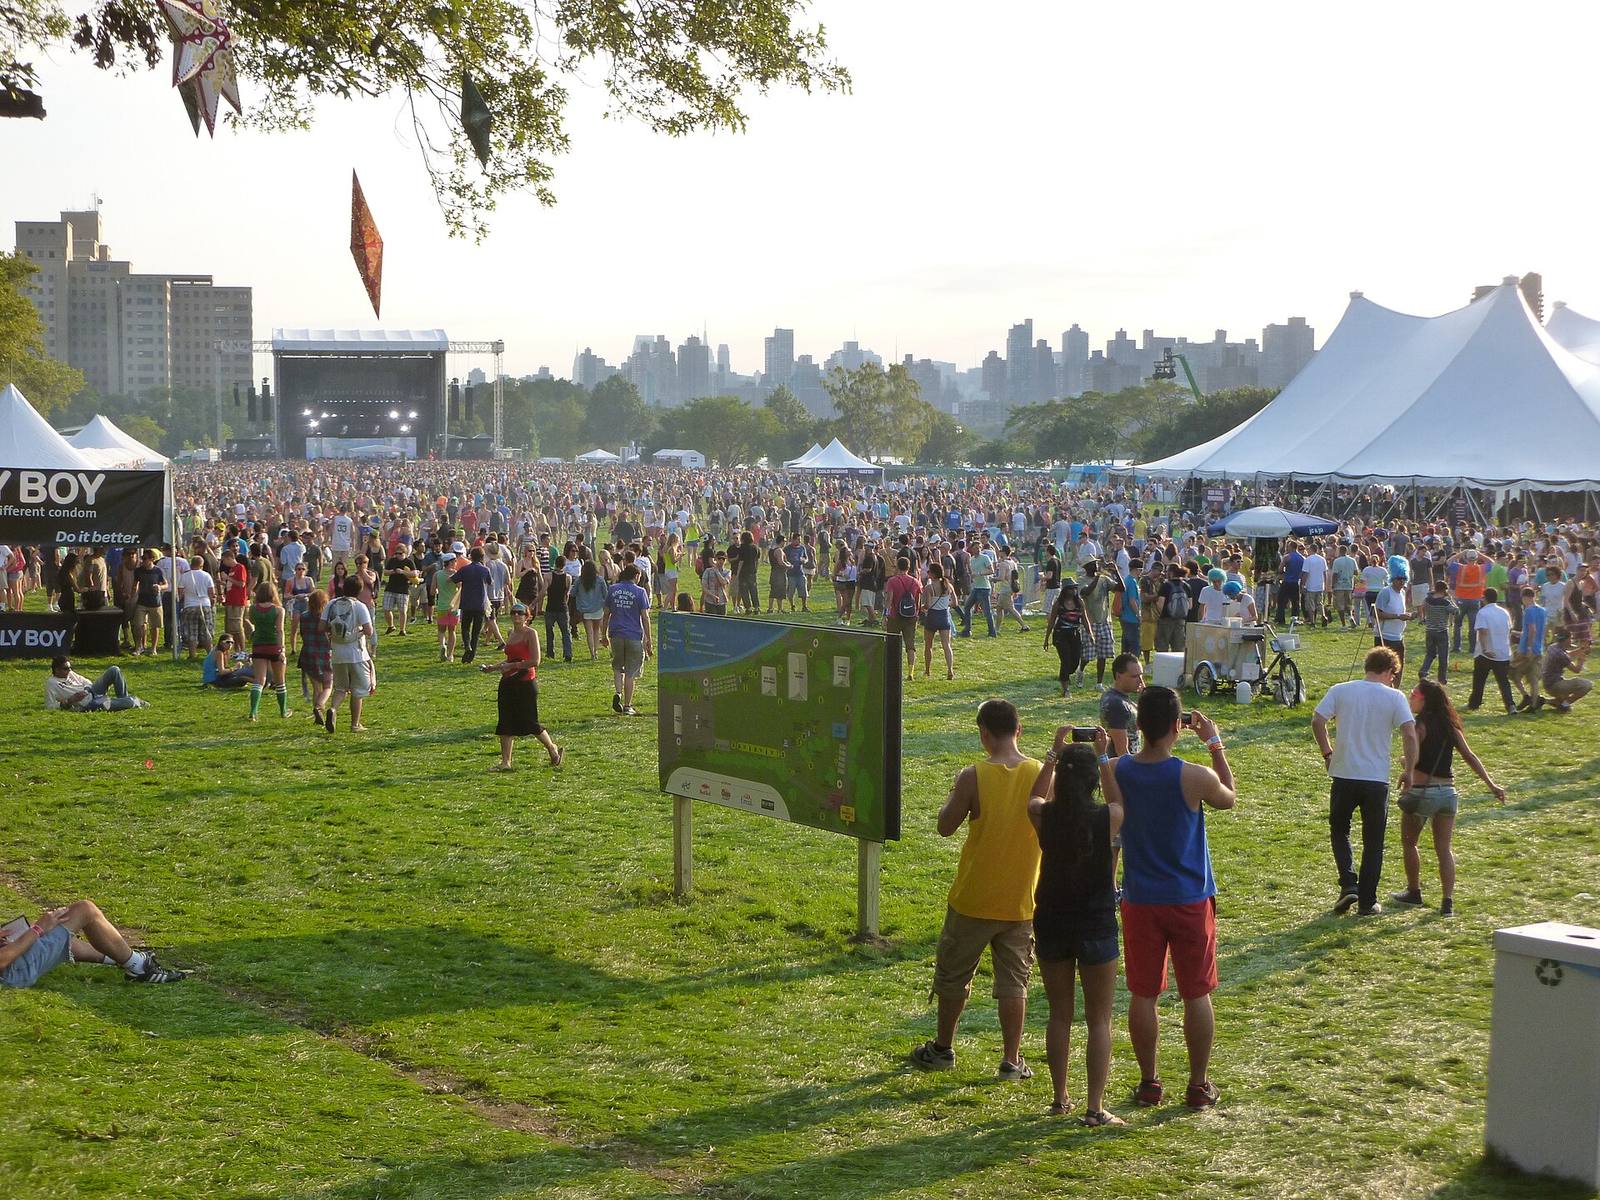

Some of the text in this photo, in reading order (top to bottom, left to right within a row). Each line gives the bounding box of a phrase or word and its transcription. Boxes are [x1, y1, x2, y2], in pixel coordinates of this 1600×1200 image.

[20, 470, 106, 505] BOY
[48, 507, 97, 518] condom
[337, 524, 347, 533] 33
[55, 530, 141, 544] Do it better.
[0, 629, 67, 647] LY BOY
